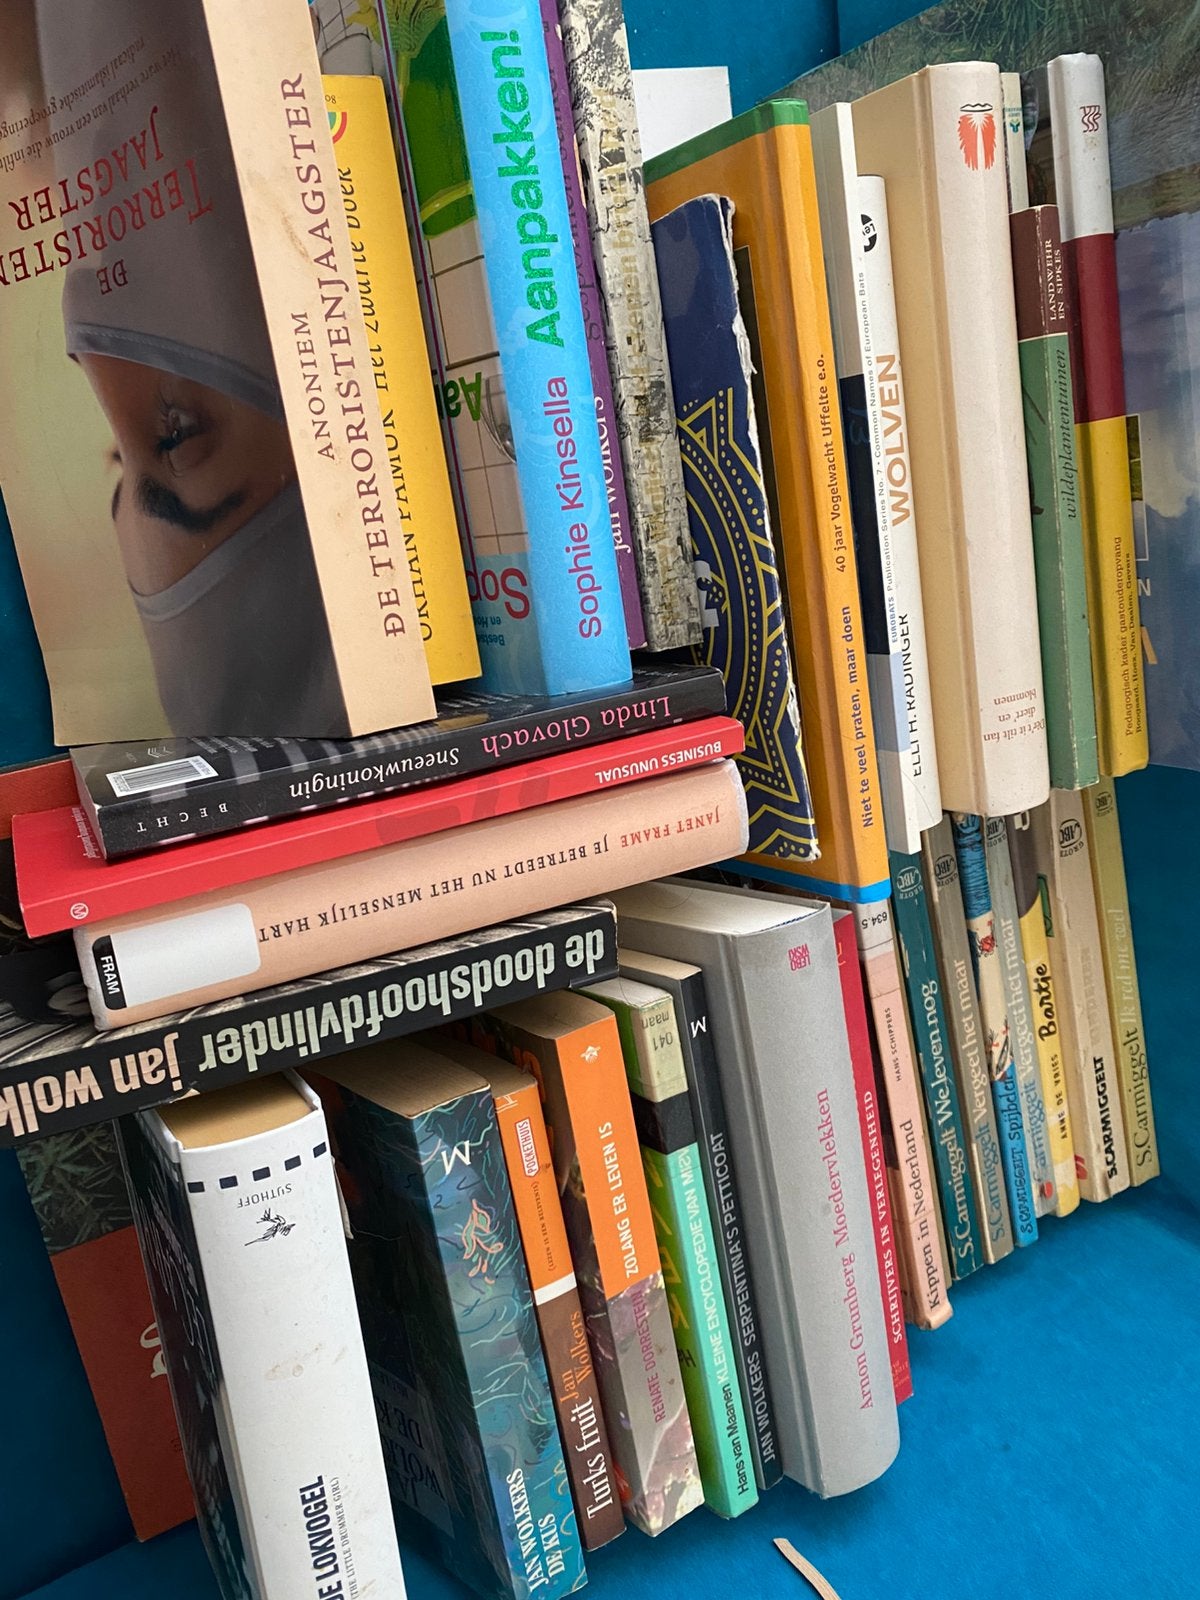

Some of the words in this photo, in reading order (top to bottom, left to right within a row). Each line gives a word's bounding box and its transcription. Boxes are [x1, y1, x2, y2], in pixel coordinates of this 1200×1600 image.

[27, 139, 43, 160] die
[45, 121, 77, 148] vrouw
[9, 105, 164, 231] JAAGSTER
[480, 29, 565, 348] Aanpakken!
[96, 260, 129, 296] DE
[858, 272, 866, 297] Bats
[1045, 238, 1057, 322] LANDWEHR
[1053, 248, 1062, 296] SIPKES
[280, 72, 394, 578] TERRORISTENJAAGSTER
[861, 300, 872, 353] European
[1058, 301, 1066, 320] EN
[816, 353, 827, 379] e.o.
[866, 355, 873, 367] of
[290, 311, 336, 461] ANONIEM
[868, 374, 876, 407] Names
[818, 383, 833, 436] Uffelte
[542, 376, 586, 511] Kinsella
[871, 410, 883, 458] Common
[876, 354, 911, 528] WOLVEN
[1054, 349, 1078, 519] wildeplantentuinen
[825, 454, 843, 528] Vogelwacht
[877, 480, 885, 497] No.
[879, 497, 890, 533] Series
[832, 530, 848, 556] jaar
[882, 534, 894, 592] Publication
[567, 521, 603, 639] Sophie
[836, 557, 846, 574] 40
[1112, 536, 1128, 633] gastouderopvang
[377, 587, 406, 637] DE
[842, 605, 854, 645] doen
[886, 596, 898, 643] EUROBATS
[847, 652, 858, 685] maar
[898, 613, 917, 708] RADINGER
[1118, 634, 1130, 669] kader
[600, 696, 671, 728] Linda
[851, 688, 867, 739] praten,
[993, 688, 1037, 706] blommen
[998, 713, 1011, 723] en
[1121, 670, 1135, 737] Pedagogisch
[481, 714, 591, 757] Glovach
[907, 711, 918, 734] H.
[984, 728, 1001, 742] fan
[1002, 725, 1017, 740] tilt
[290, 747, 459, 799] Sneeuwkoningin
[595, 756, 659, 784] UNUSUAL
[662, 741, 722, 765] BUSINESS
[855, 740, 868, 768] veel
[859, 770, 870, 788] te
[136, 802, 229, 833] BECHT
[676, 805, 721, 834] JANET
[862, 798, 875, 828] Niet
[593, 834, 610, 855] JE
[620, 823, 671, 849] FRAME
[472, 868, 497, 888] NU
[503, 845, 588, 879] BETREEDT
[317, 887, 422, 928] MENSELIJK
[430, 877, 465, 899] HET
[259, 918, 311, 943] HART
[861, 911, 888, 930] 634.5
[564, 928, 605, 975] de
[1001, 917, 1018, 970] maar
[100, 955, 120, 995] FRAM
[953, 959, 972, 1013] maar
[1007, 969, 1025, 1006] het
[199, 942, 555, 1073] doodshoofdvlinder
[641, 1011, 670, 1030] maan
[921, 980, 941, 1031] nog
[1034, 963, 1057, 1042] Bartje
[652, 1031, 674, 1051] 041
[884, 1006, 899, 1056] SCHIPPERS
[960, 1015, 978, 1049] het
[1013, 1004, 1034, 1081] Vergeet
[112, 1031, 184, 1092] jan
[889, 1058, 901, 1083] HANS
[1050, 1053, 1062, 1087] VRIES
[931, 1086, 954, 1126] We
[967, 1047, 988, 1124] Vergeet
[1055, 1090, 1065, 1106] DE
[1123, 1027, 1153, 1168] S.Carmiggelt
[598, 1121, 613, 1139] IS
[1093, 1056, 1118, 1180] S.CARMIGGELT
[516, 1120, 538, 1175] POCKETHUIS
[603, 1144, 623, 1188] LEVEN
[816, 1088, 850, 1248] Moedervlekken
[864, 1090, 889, 1220] VERLEGENHEID
[899, 1118, 926, 1218] Nederland
[710, 1132, 736, 1223] PETTICOAT
[939, 1127, 974, 1259] S.Carmiggelt
[976, 1122, 1005, 1242] S.Carmiggelt
[612, 1191, 628, 1215] ER
[685, 1190, 701, 1219] VAN
[617, 1218, 640, 1279] ZOLANG
[880, 1227, 891, 1246] IN
[916, 1218, 931, 1245] in
[687, 1221, 722, 1330] ENCYCLOPEDIE
[725, 1226, 756, 1347] SERPENTINA'S
[880, 1248, 904, 1344] SCHRIJVERS
[919, 1247, 940, 1310] Kippen
[836, 1253, 866, 1356] Grunberg
[563, 1309, 595, 1385] Wolkers
[630, 1291, 658, 1372] DORRESTEIN
[709, 1332, 729, 1386] KLEINE
[559, 1369, 579, 1404] Jan
[645, 1372, 666, 1424] RENATE
[746, 1351, 770, 1441] WOLKERS
[850, 1358, 874, 1410] Arnon
[570, 1396, 600, 1452] fruit
[721, 1382, 740, 1442] Maanen
[730, 1443, 744, 1464] van
[760, 1441, 777, 1464] JAN
[330, 1476, 342, 1502] GIRL)
[583, 1453, 614, 1520] Turks
[734, 1461, 750, 1495] Hans
[299, 1475, 339, 1581] LOKVOGEL
[335, 1502, 350, 1547] DRUMMER
[507, 1467, 540, 1552] WOLKERS
[538, 1512, 561, 1553] KUS
[343, 1547, 356, 1578] LITTLE
[524, 1554, 549, 1593] JAN
[544, 1552, 566, 1579] DE
